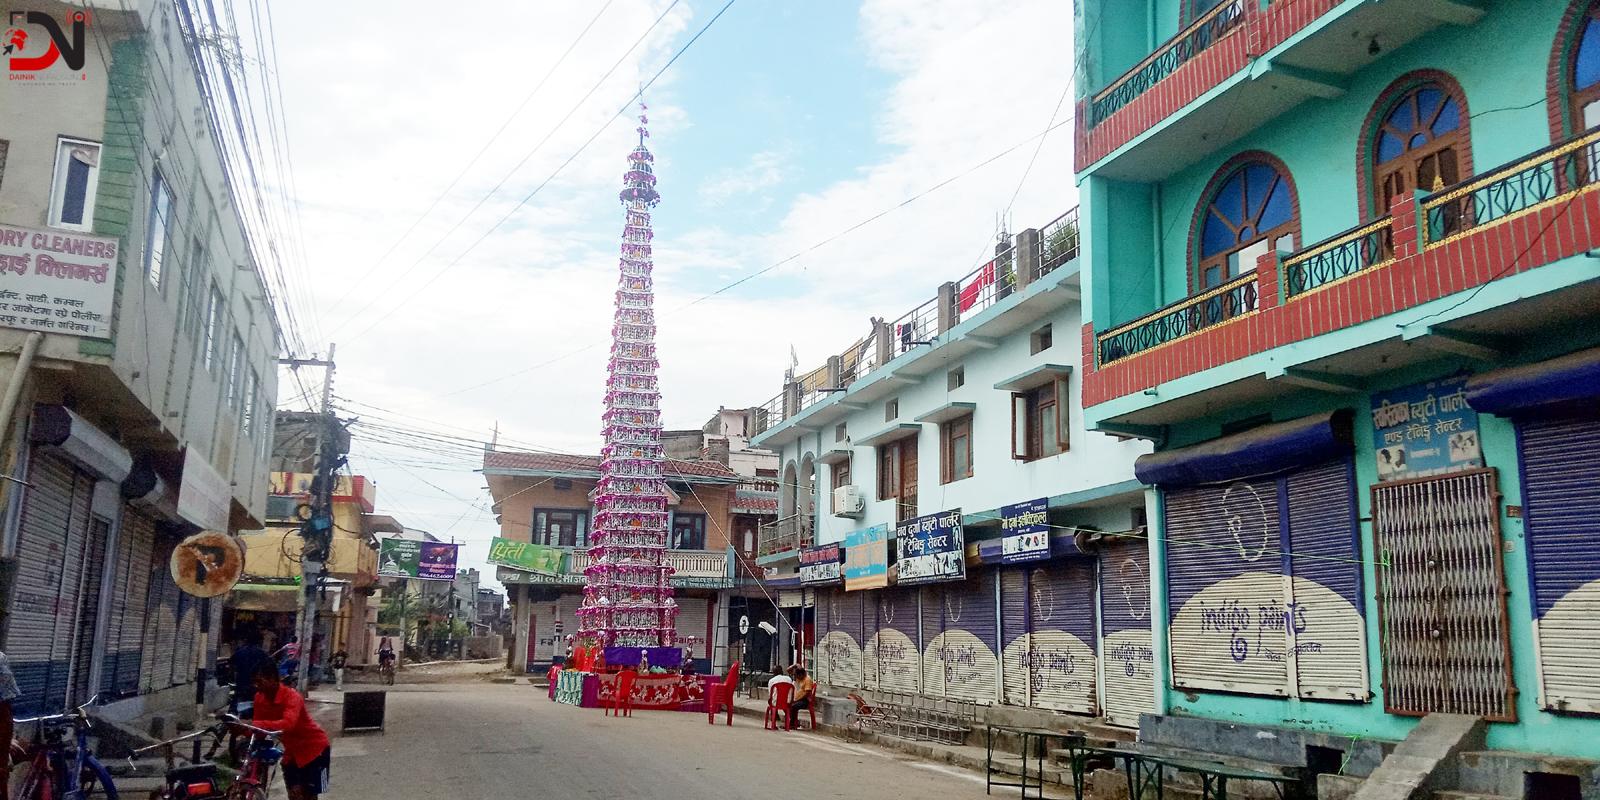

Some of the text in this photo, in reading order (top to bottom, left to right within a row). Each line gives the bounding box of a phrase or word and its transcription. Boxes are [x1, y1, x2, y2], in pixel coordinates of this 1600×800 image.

[31, 233, 117, 260] CLEANERS
[1435, 418, 1463, 435] सेन्टर
[896, 526, 907, 537] नव
[908, 520, 921, 538] दुर्गा
[939, 511, 960, 528] पार्लर
[927, 535, 948, 549] सेन्टर
[1200, 598, 1250, 634] indigo
[1049, 645, 1075, 675] paints
